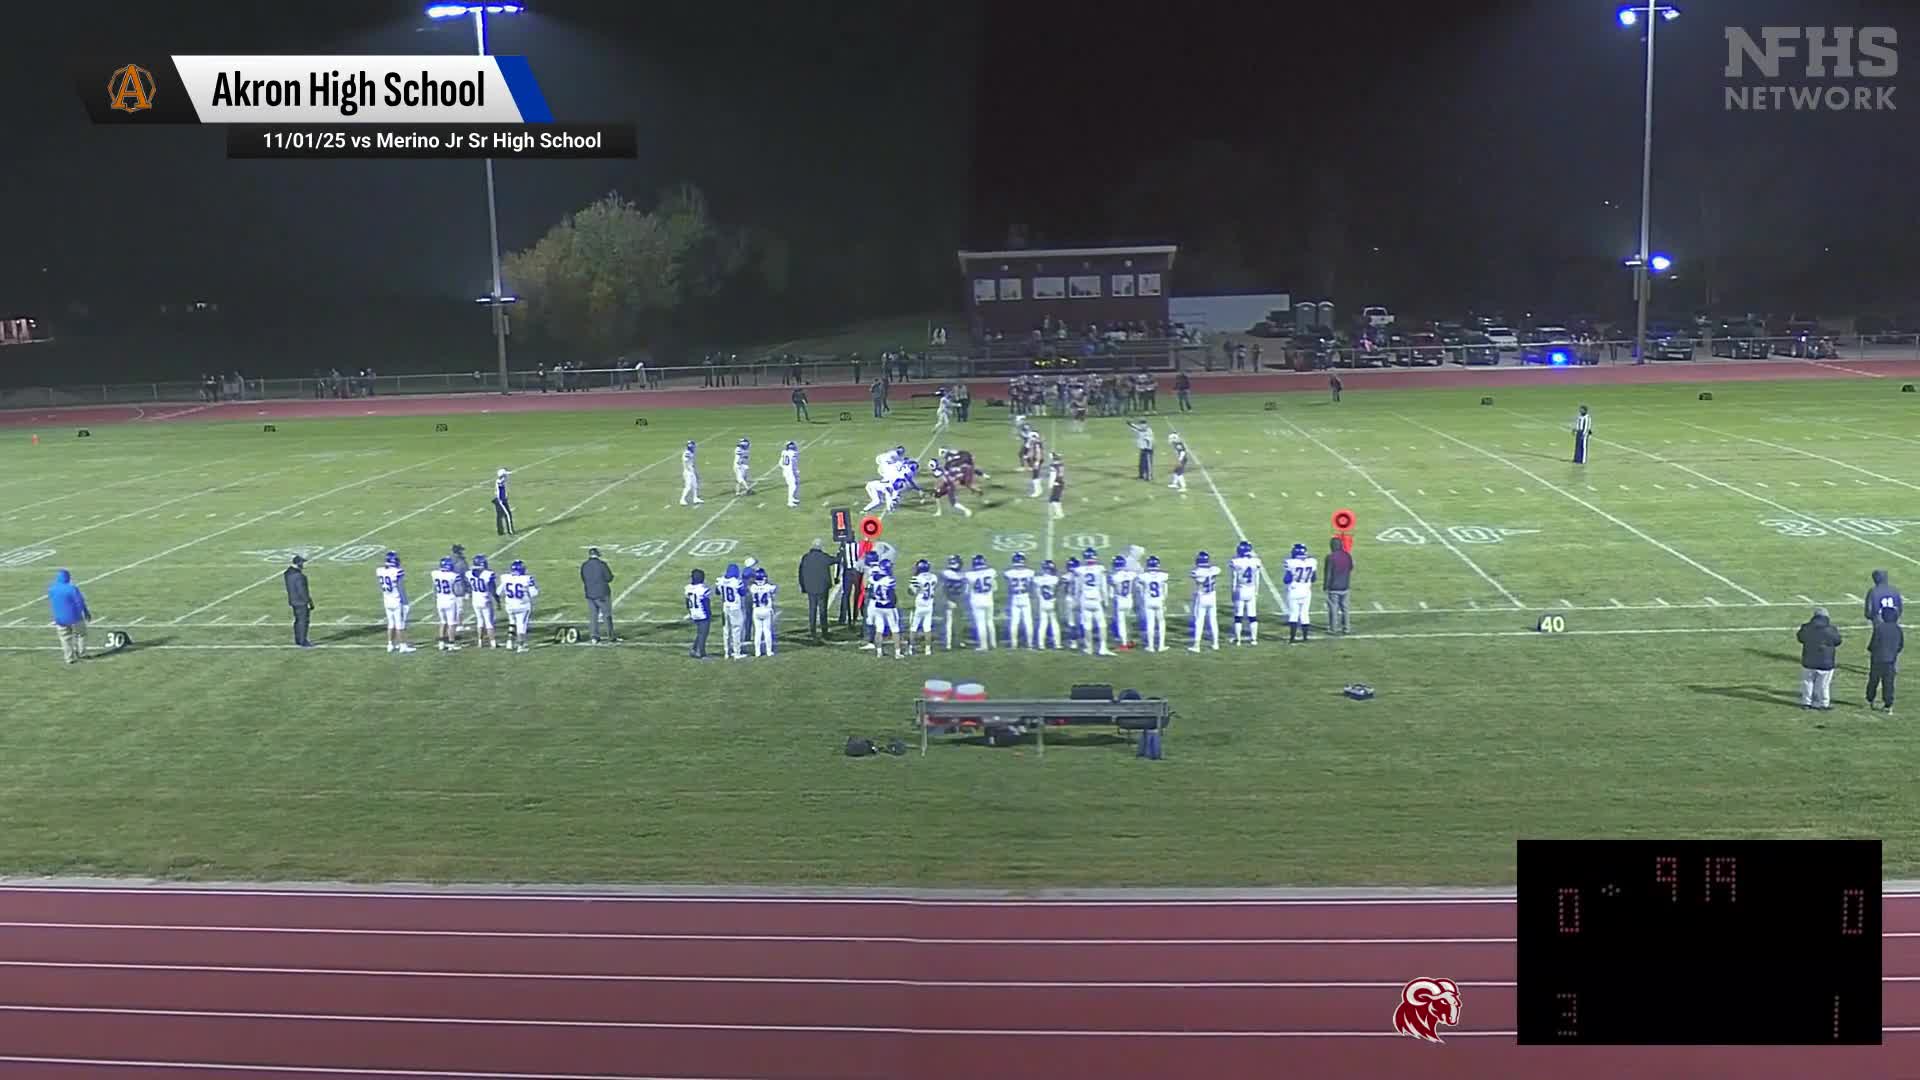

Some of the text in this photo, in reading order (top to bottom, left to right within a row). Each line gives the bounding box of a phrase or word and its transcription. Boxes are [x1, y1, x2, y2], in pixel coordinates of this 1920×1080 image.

[836, 511, 846, 530] 1
[1084, 573, 1096, 587] 2
[1242, 566, 1253, 583] 4
[1294, 567, 1313, 583] 77
[506, 582, 524, 600] 56
[974, 576, 992, 593] 45
[1541, 616, 1565, 633] 40
[104, 632, 125, 648] 30
[555, 628, 578, 644] 40
